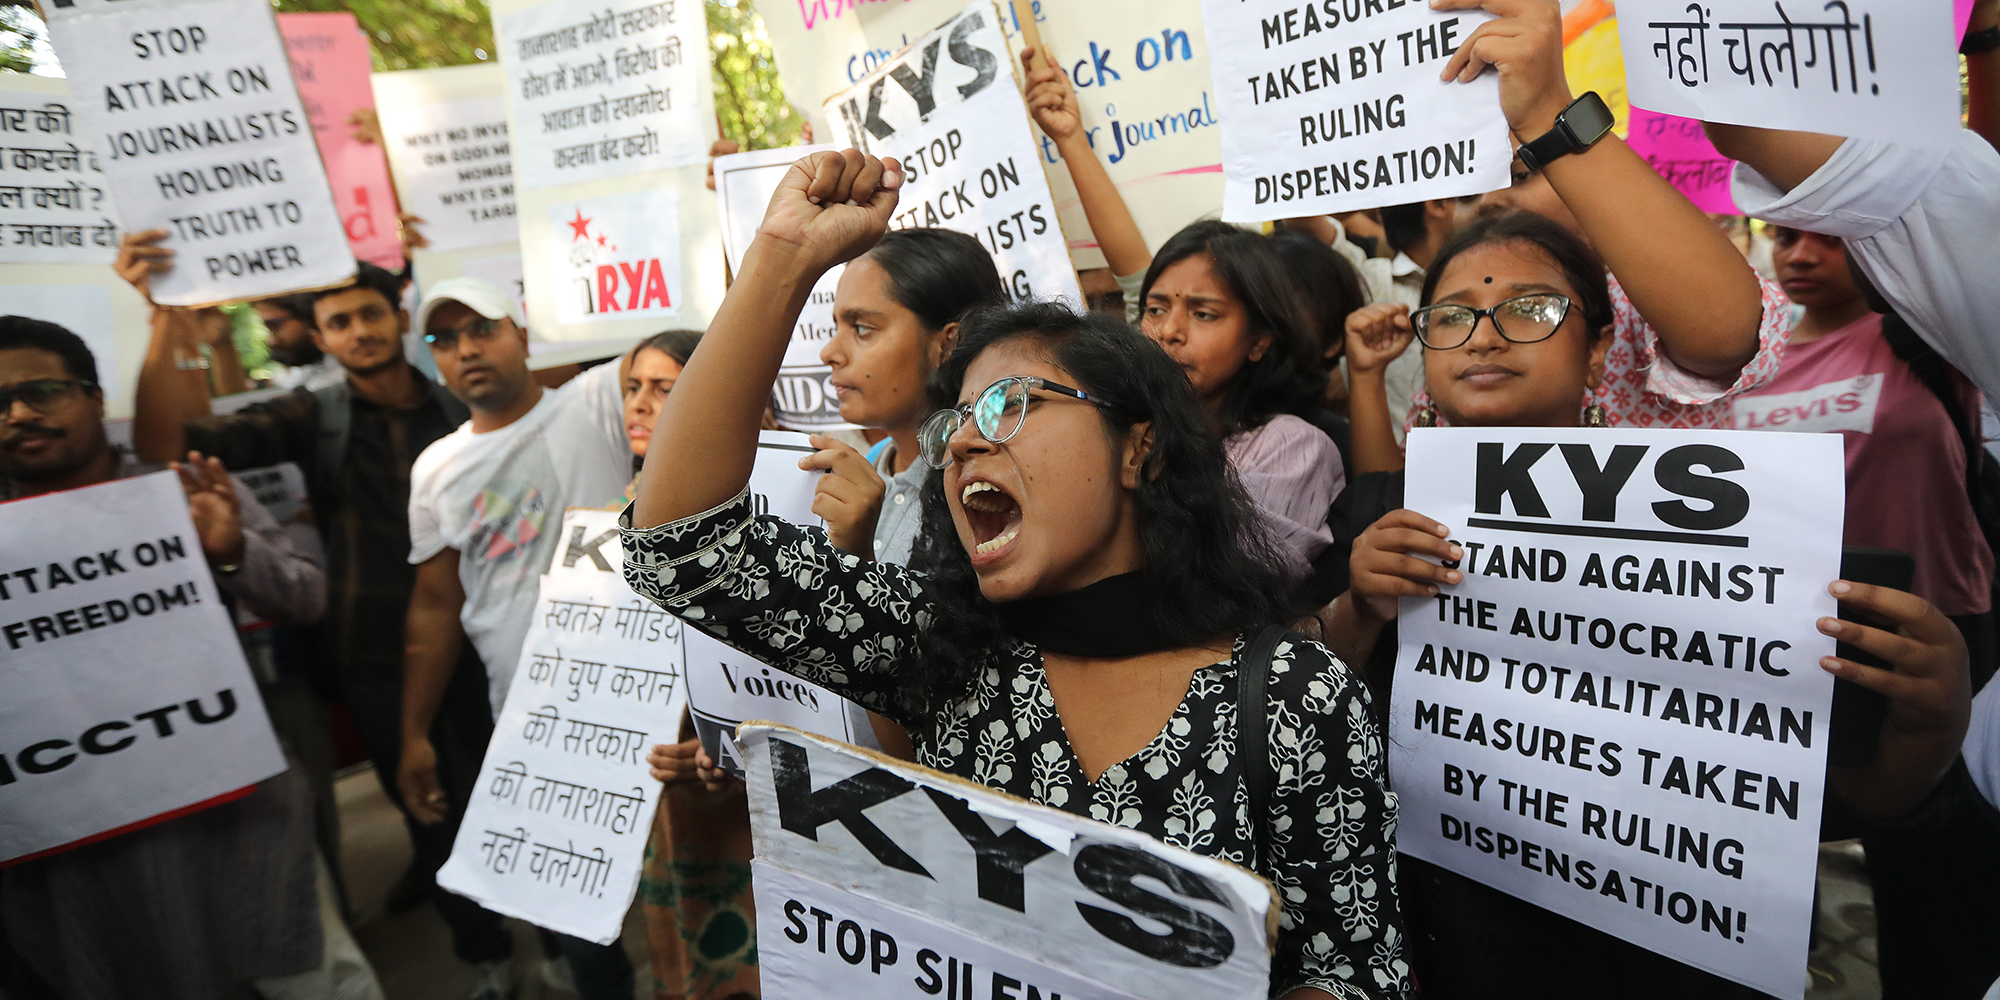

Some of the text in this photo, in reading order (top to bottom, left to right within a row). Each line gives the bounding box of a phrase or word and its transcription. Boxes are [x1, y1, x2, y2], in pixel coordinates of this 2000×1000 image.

[131, 26, 208, 59] STOP
[619, 1, 677, 35] सरकार
[1261, 0, 1423, 49] MEASUR
[660, 36, 683, 65] की
[1135, 28, 1193, 71] on
[1248, 17, 1459, 106] TAKEN BY THE
[1648, 0, 1880, 97] नहीं चलेगी!
[104, 72, 222, 112] ATTACK
[227, 65, 271, 94] ON
[589, 94, 609, 123] को
[839, 10, 998, 154] KYS
[31, 103, 72, 135] की
[107, 109, 299, 159] JOURNALISTS
[1299, 93, 1407, 147] RULING
[10, 142, 81, 171] करने
[155, 158, 285, 200] HOLDING
[903, 129, 962, 184] STOP
[1254, 138, 1477, 205] DISPENSATION!
[31, 179, 87, 209] क्यों
[896, 157, 1020, 228] TTACK ON
[10, 224, 83, 246] जवाब
[93, 218, 117, 246] दो
[172, 200, 303, 243] TRUTH TO
[207, 245, 304, 280] POWER
[1475, 442, 1751, 531] KYS
[0, 535, 188, 600] TTACK ON
[1579, 552, 1784, 605] AGAINST
[2, 581, 201, 650] FREEDOM!
[545, 596, 680, 645] स्वतंत्र मीडिय
[1434, 593, 1792, 678] THE AUTOCRATIC
[528, 647, 680, 706] को चुप कराने
[719, 662, 819, 713] Voices
[1414, 643, 1813, 749] AND TOTALITARIAN
[522, 705, 648, 766] की सरकार
[1413, 699, 1800, 821] MEASURES TAKEN
[490, 762, 647, 835] की तानाशाही
[1443, 763, 1745, 880] BY THE RULING
[481, 827, 613, 899] नहीं चलेगी!
[768, 736, 1236, 969] KYS
[1440, 812, 1748, 944] DISPENSATION!
[783, 899, 898, 975] STOP
